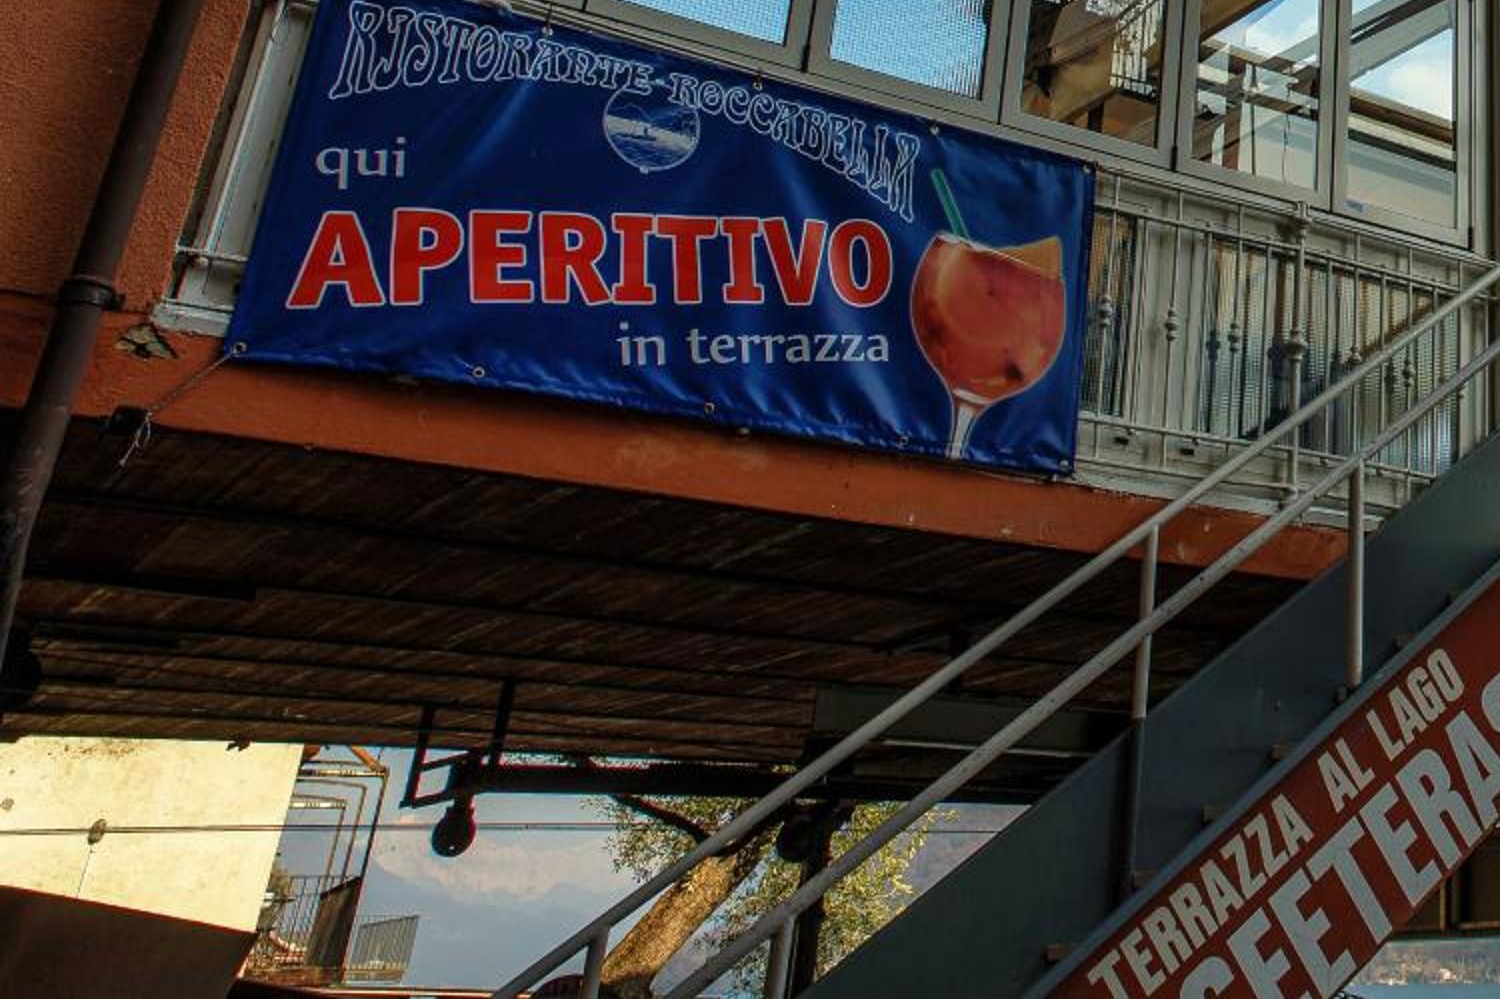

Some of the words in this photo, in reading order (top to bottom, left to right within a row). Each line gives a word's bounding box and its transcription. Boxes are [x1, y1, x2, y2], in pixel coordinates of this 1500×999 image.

[315, 136, 407, 189] qui
[330, 0, 654, 100] RISTORANTE
[668, 72, 920, 224] ROCCABELLA
[285, 206, 894, 308] APERITIVO
[618, 321, 667, 368] in
[688, 328, 890, 365] terrazza
[1087, 793, 1315, 999] TERRAZZA
[1316, 741, 1375, 809] AL
[1366, 648, 1465, 761] LAGO
